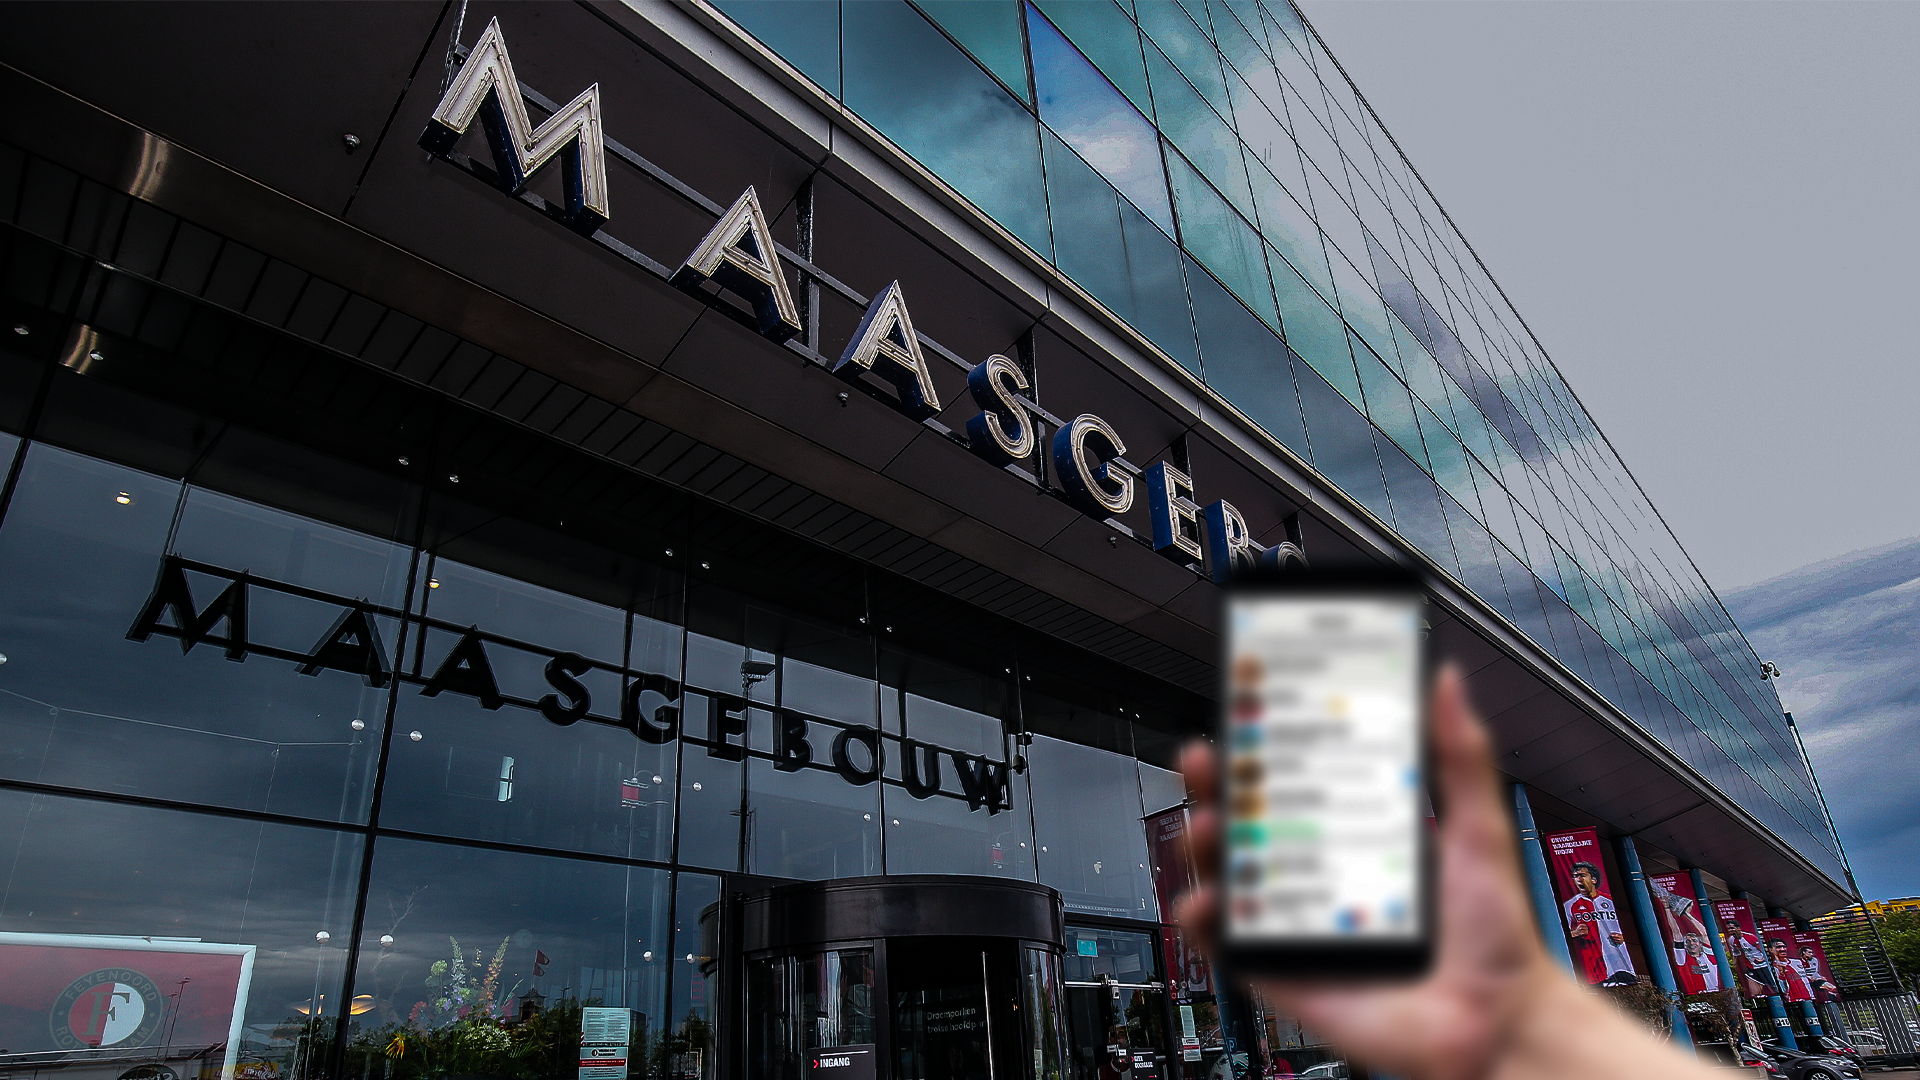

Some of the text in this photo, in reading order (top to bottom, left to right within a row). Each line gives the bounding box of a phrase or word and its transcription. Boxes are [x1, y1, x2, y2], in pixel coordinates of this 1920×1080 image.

[417, 16, 1312, 576] MAASGEB
[125, 554, 1014, 816] MAASGEBOUW
[1574, 910, 1616, 923] FORTIS
[65, 970, 158, 1001] FEYENOORD
[819, 1057, 851, 1068] INGANG
